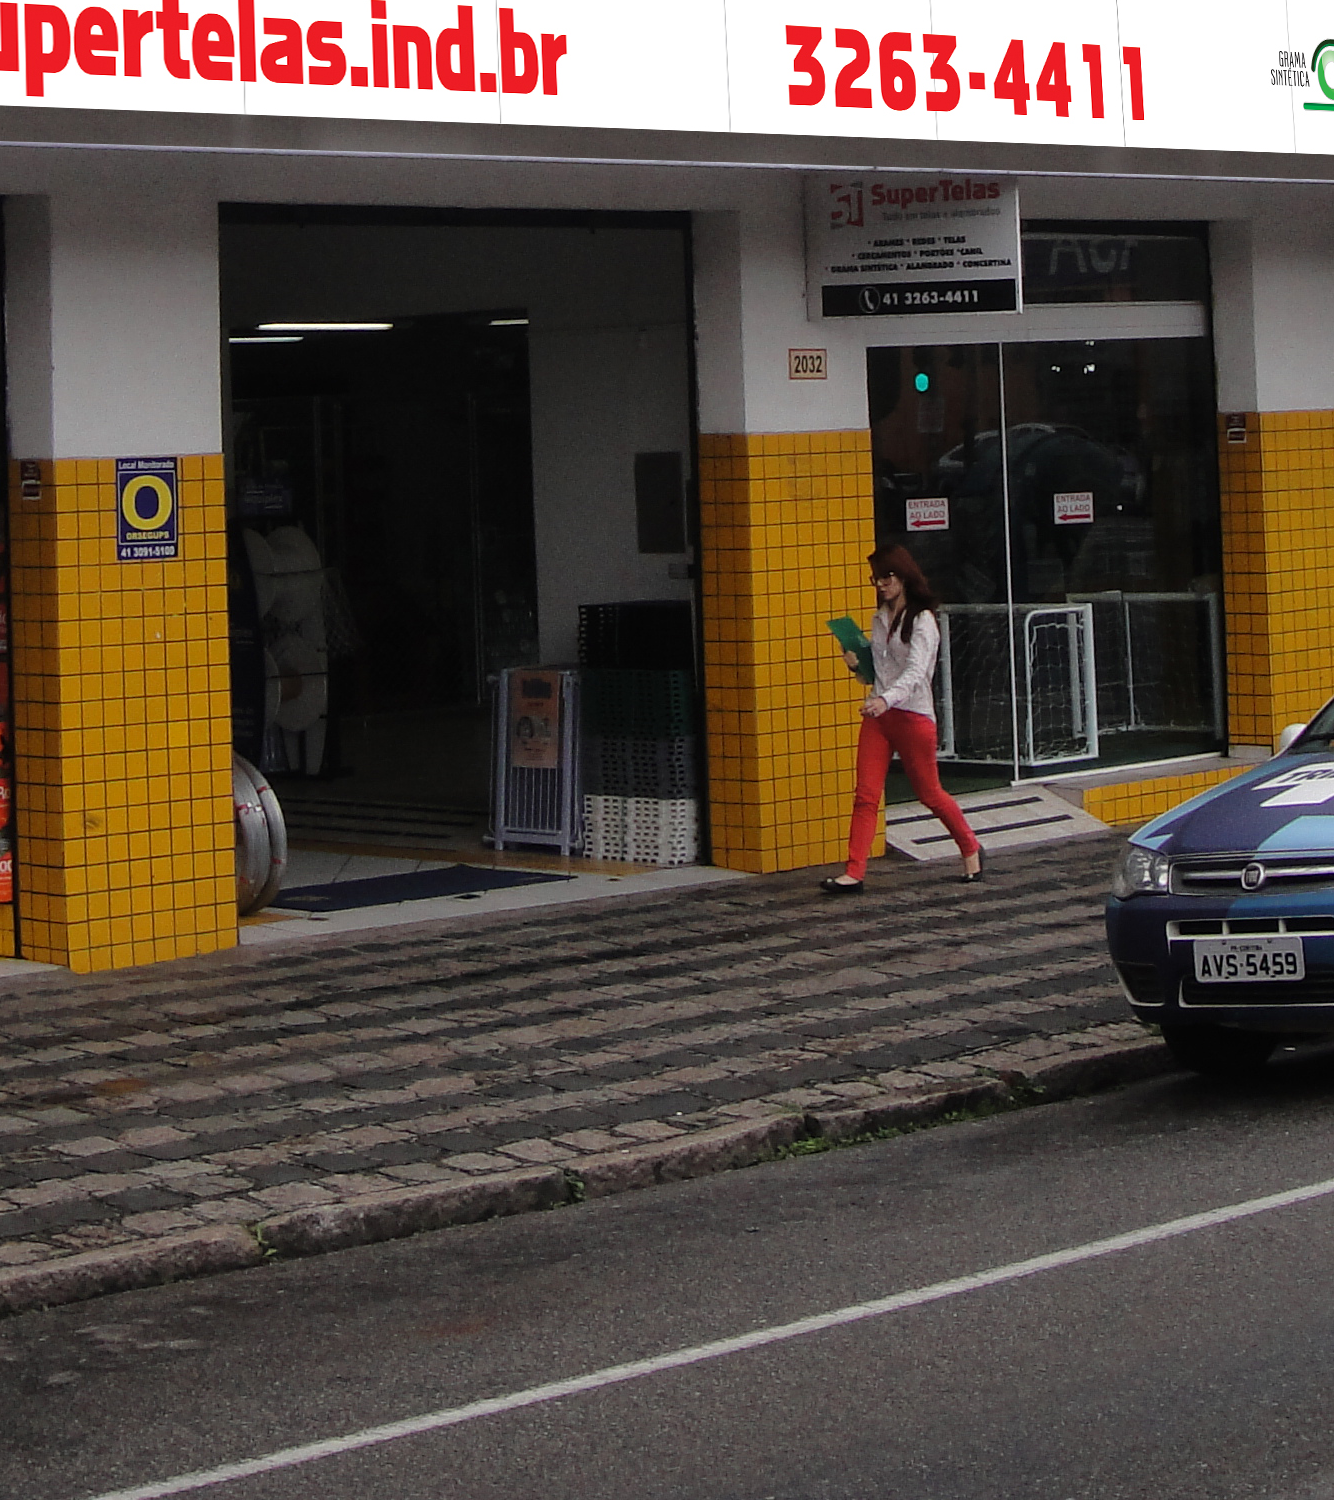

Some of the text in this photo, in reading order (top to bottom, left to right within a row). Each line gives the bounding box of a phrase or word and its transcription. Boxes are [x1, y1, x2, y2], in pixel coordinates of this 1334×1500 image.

[1278, 50, 1307, 69] GRAMA
[785, 25, 1145, 121] 3263-4411
[1270, 67, 1311, 88] SINTÉTICA
[870, 179, 1001, 210] SuperTelas
[882, 289, 979, 306] 41 3263-4411
[793, 355, 824, 375] 2032
[908, 500, 946, 509] ENTRADA
[1055, 494, 1091, 503] ENTRADA
[120, 547, 131, 558] 41
